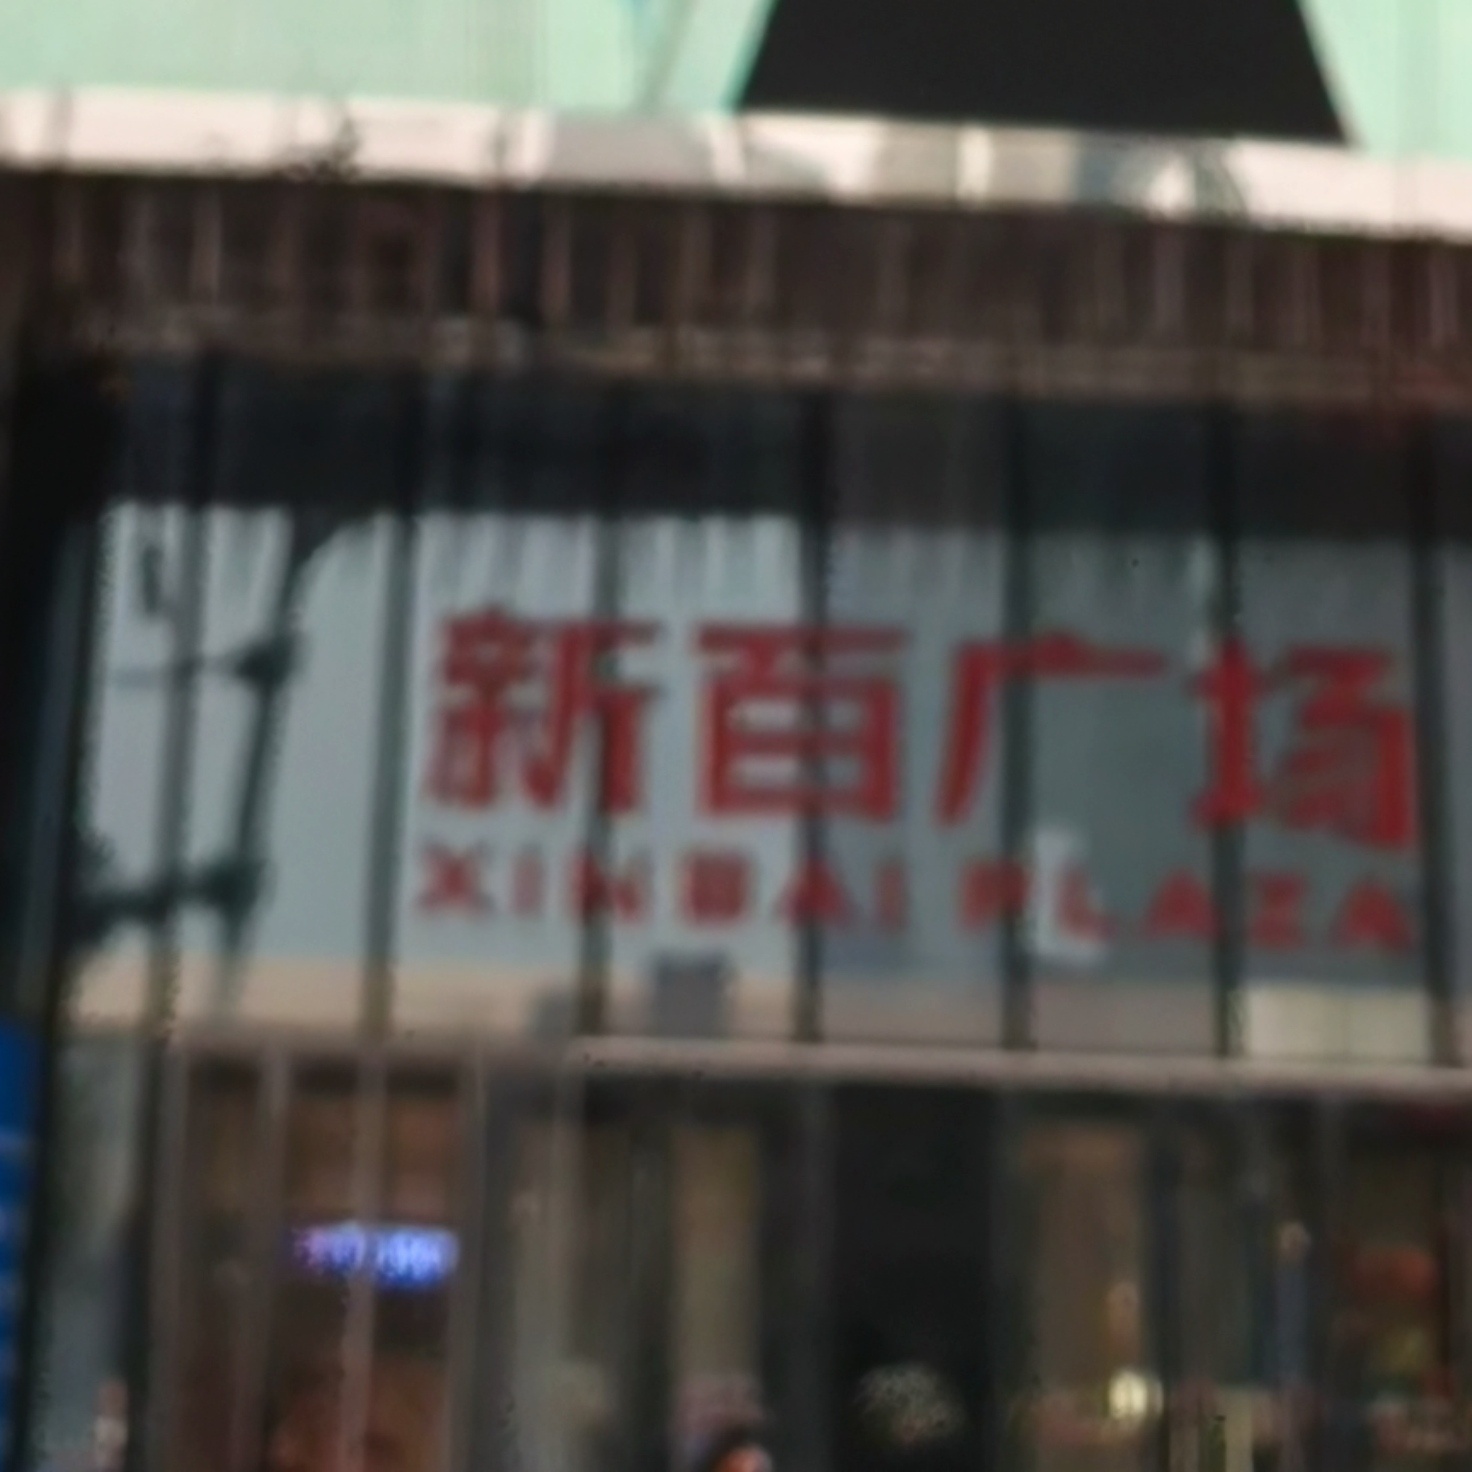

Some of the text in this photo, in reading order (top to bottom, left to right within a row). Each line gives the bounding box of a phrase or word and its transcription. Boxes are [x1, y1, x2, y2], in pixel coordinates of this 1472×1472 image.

[426, 602, 1418, 848] 新百广场
[416, 846, 1414, 950] XINBAI PLAZA
